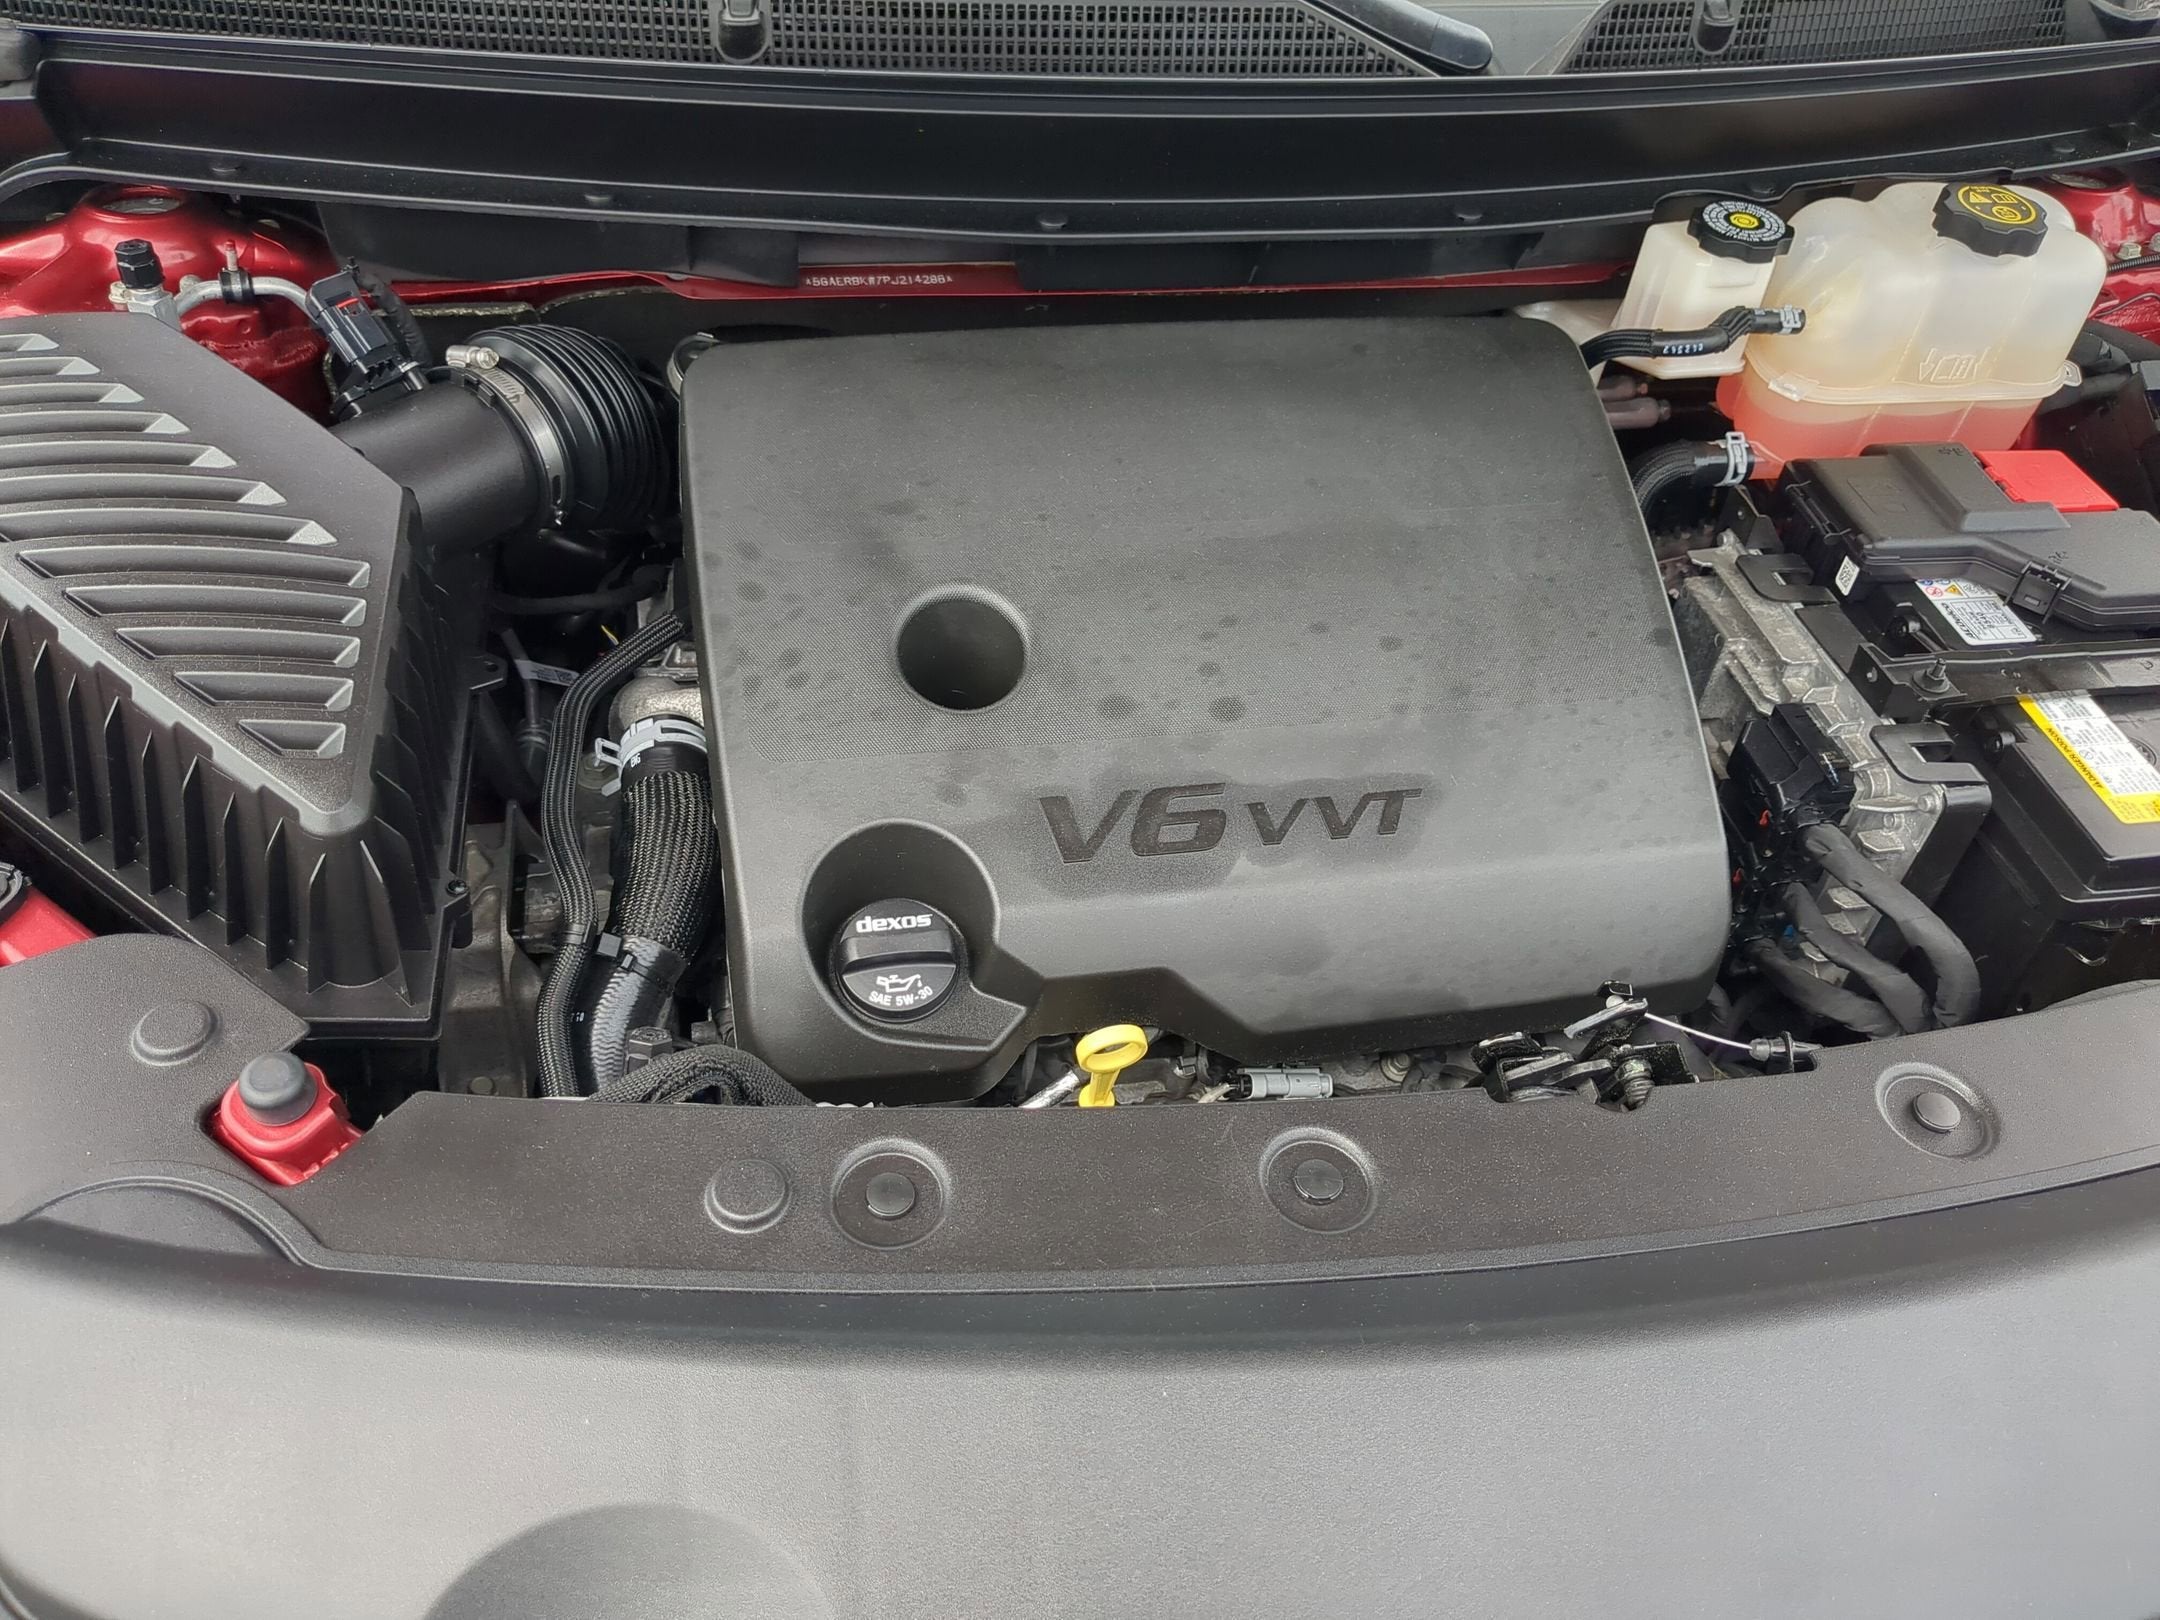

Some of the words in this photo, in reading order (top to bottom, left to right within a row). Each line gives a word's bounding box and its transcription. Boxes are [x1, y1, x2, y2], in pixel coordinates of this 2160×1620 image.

[1040, 783, 1226, 863] V6
[1248, 788, 1422, 846] VVT
[856, 913, 933, 933] dexos
[869, 990, 892, 1006] SAE
[896, 985, 934, 1007] 5W-30
